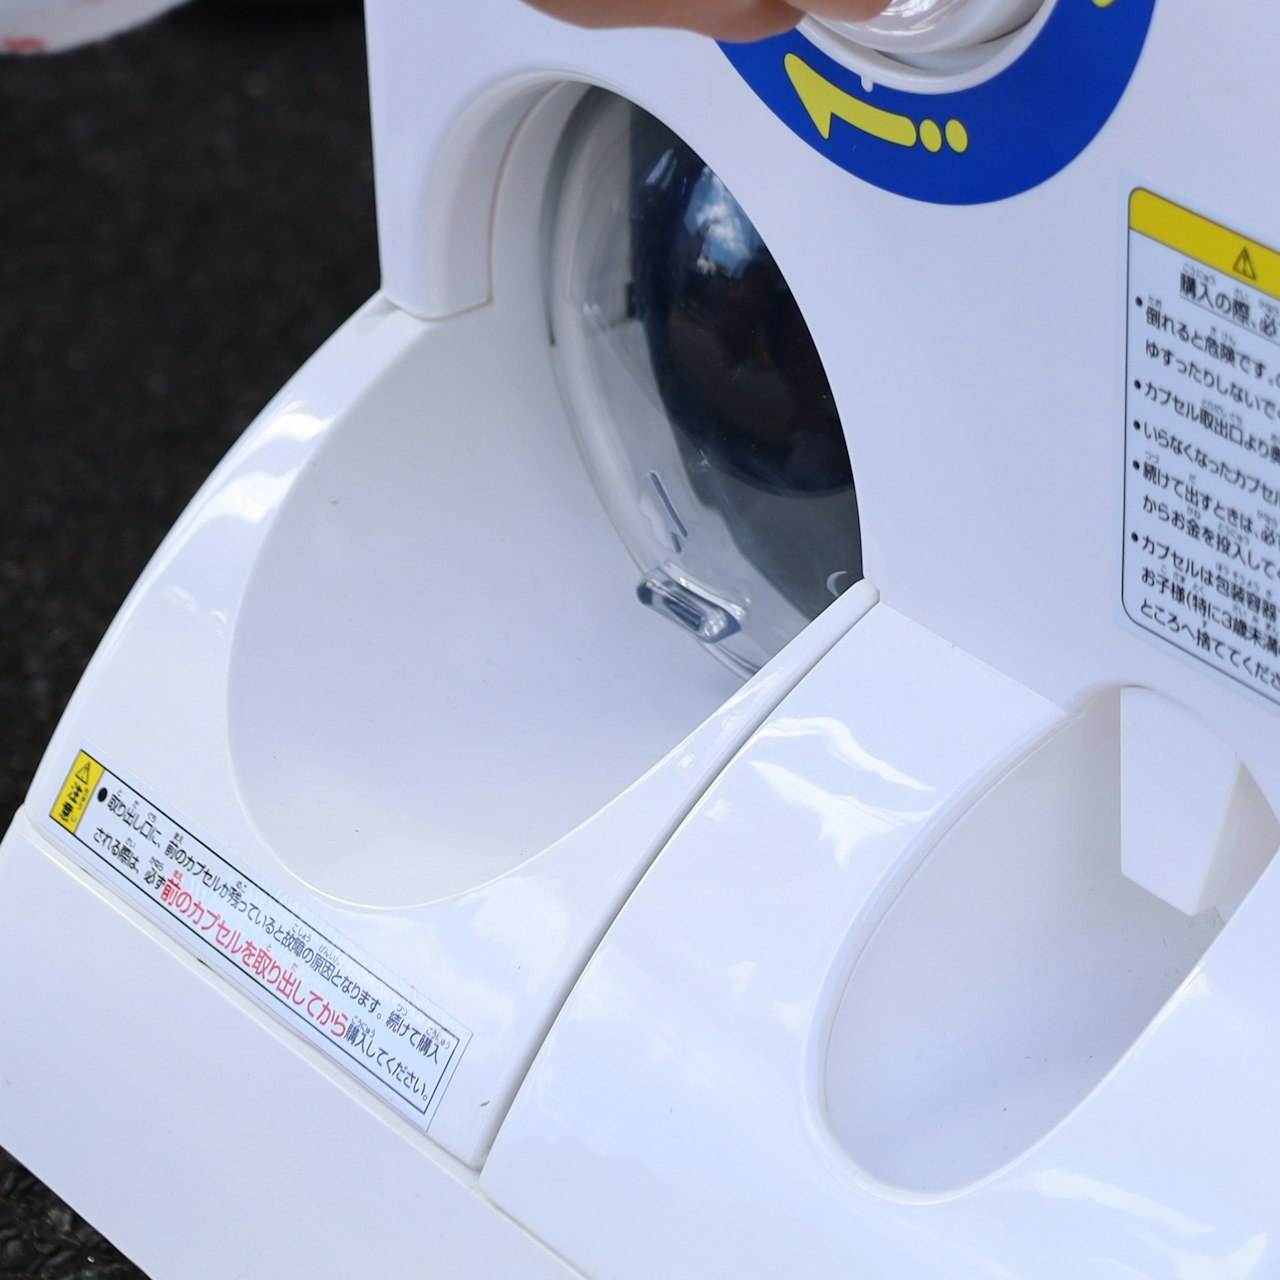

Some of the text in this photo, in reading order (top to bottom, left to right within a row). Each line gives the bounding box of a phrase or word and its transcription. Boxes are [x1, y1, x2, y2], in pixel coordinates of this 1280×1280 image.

[92, 826, 432, 1106] される際は、必ず前のカプセルを取り出してから購入してください。
[105, 793, 443, 1065] 取り出し口に、前のカプセルが残っていると故障の原因となります。続けて購入
